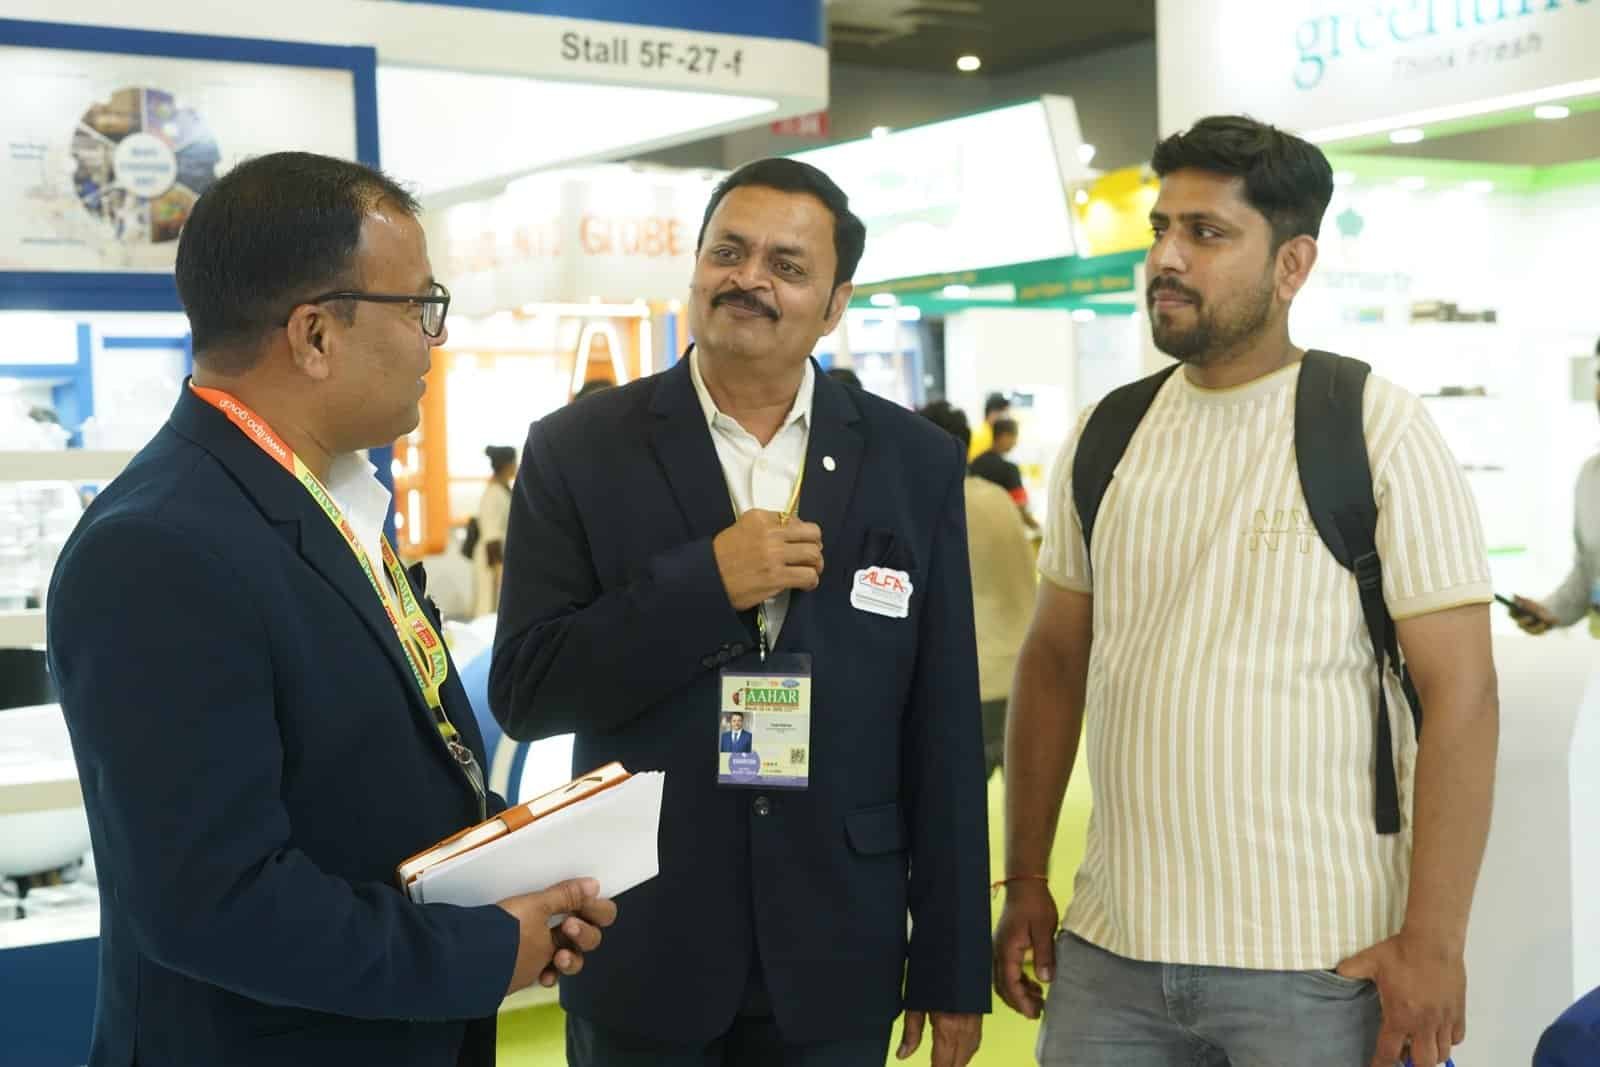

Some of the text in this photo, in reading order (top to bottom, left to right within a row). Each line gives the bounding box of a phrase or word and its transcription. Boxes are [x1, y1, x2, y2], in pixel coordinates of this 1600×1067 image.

[561, 31, 743, 78] Stall 5F-27-f
[748, 688, 798, 704] AAHAR
